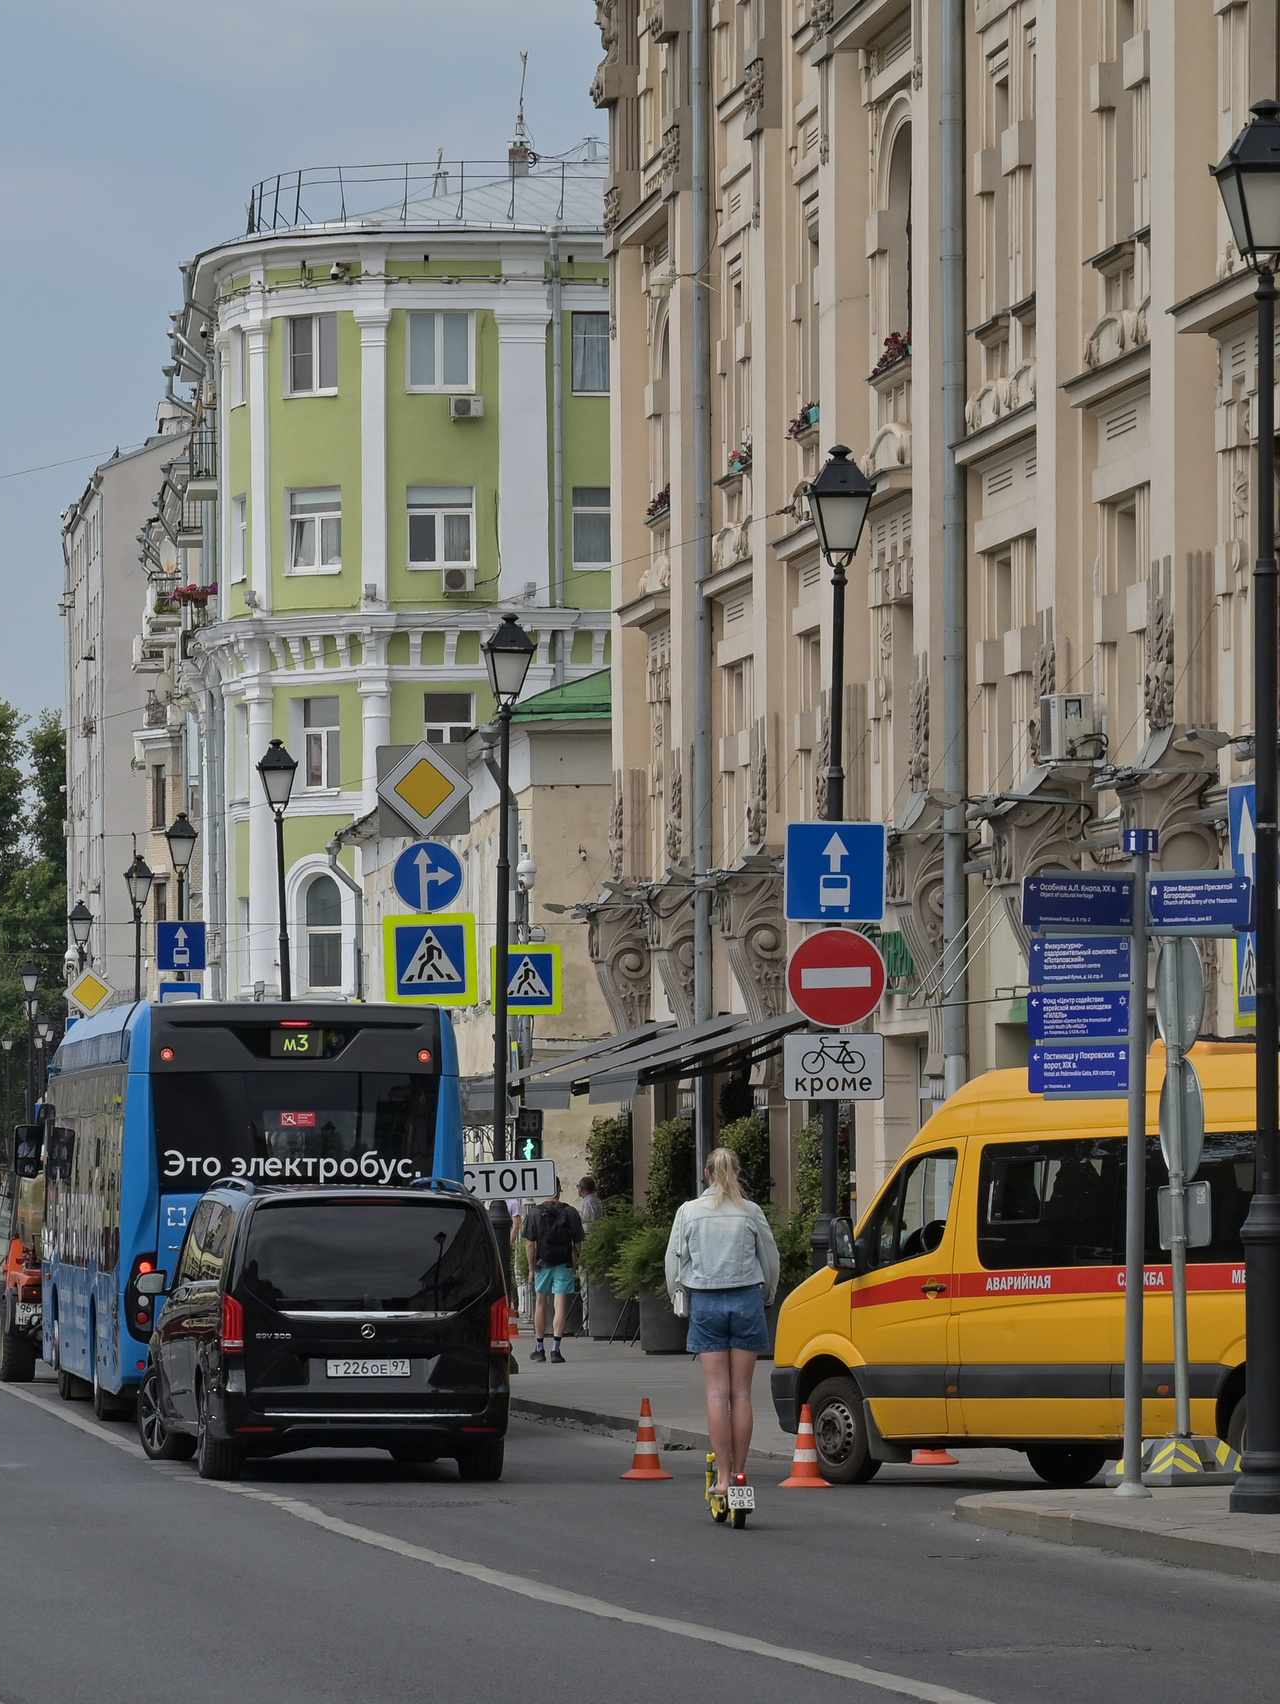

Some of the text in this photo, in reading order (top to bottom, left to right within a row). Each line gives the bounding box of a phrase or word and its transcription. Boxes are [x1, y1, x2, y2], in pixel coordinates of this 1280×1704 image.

[1040, 883, 1067, 891] Особняк
[1204, 883, 1232, 891] Пресвятой
[1044, 949, 1091, 957] оздоровительный
[1075, 1053, 1079, 1061] у
[1080, 1051, 1115, 1060] Покровских
[1043, 1062, 1061, 1070] ворот,
[795, 1076, 872, 1097] кроме
[163, 1149, 421, 1184] Это электробус.
[985, 1272, 1051, 1292] АВАРИЙНАЯ
[1117, 1271, 1164, 1287] СЖБА
[274, 1332, 291, 1340] 300
[730, 1488, 753, 1497] 300
